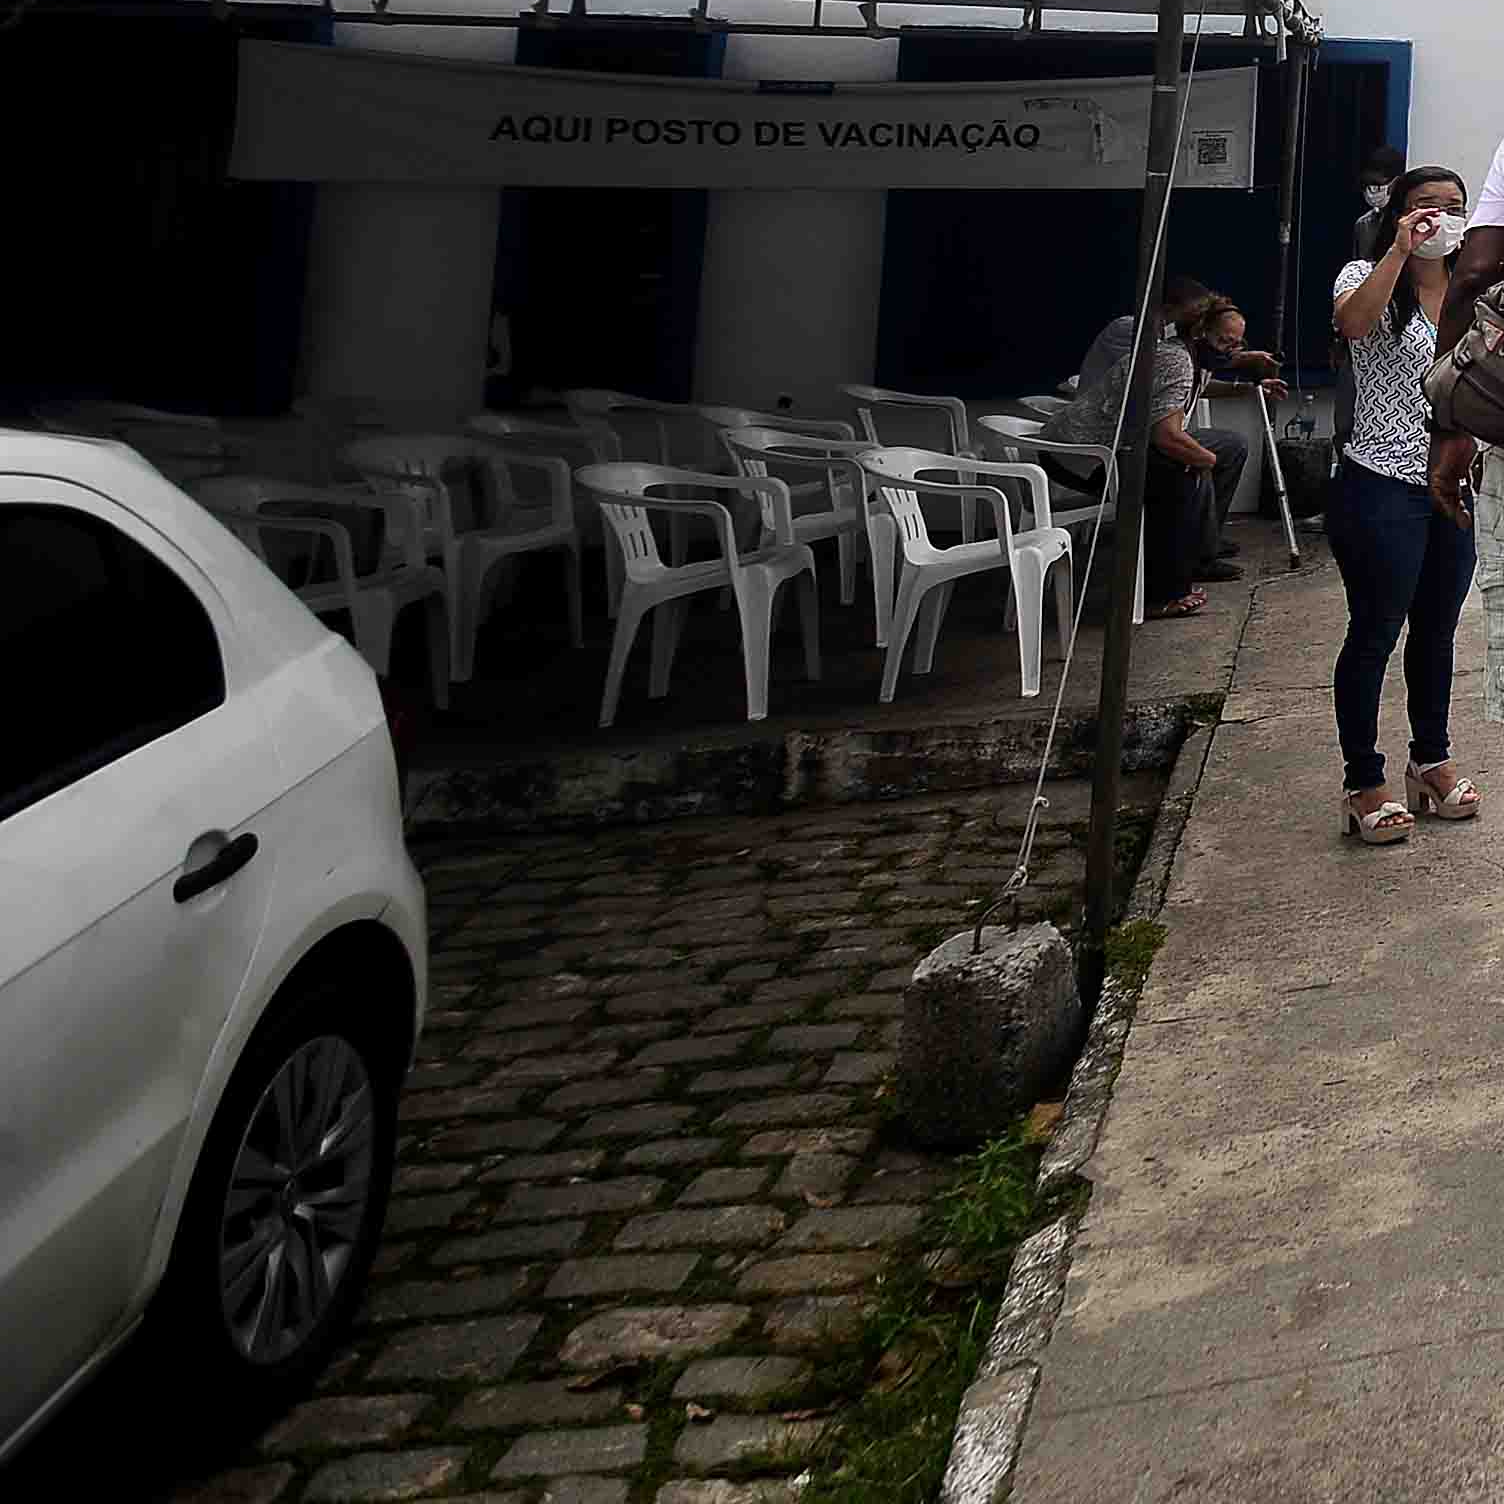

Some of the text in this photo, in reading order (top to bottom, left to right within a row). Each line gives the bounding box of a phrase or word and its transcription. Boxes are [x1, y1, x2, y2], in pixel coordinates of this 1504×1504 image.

[489, 113, 1042, 153] AQUI POSTO DE VACINAÇÃO
